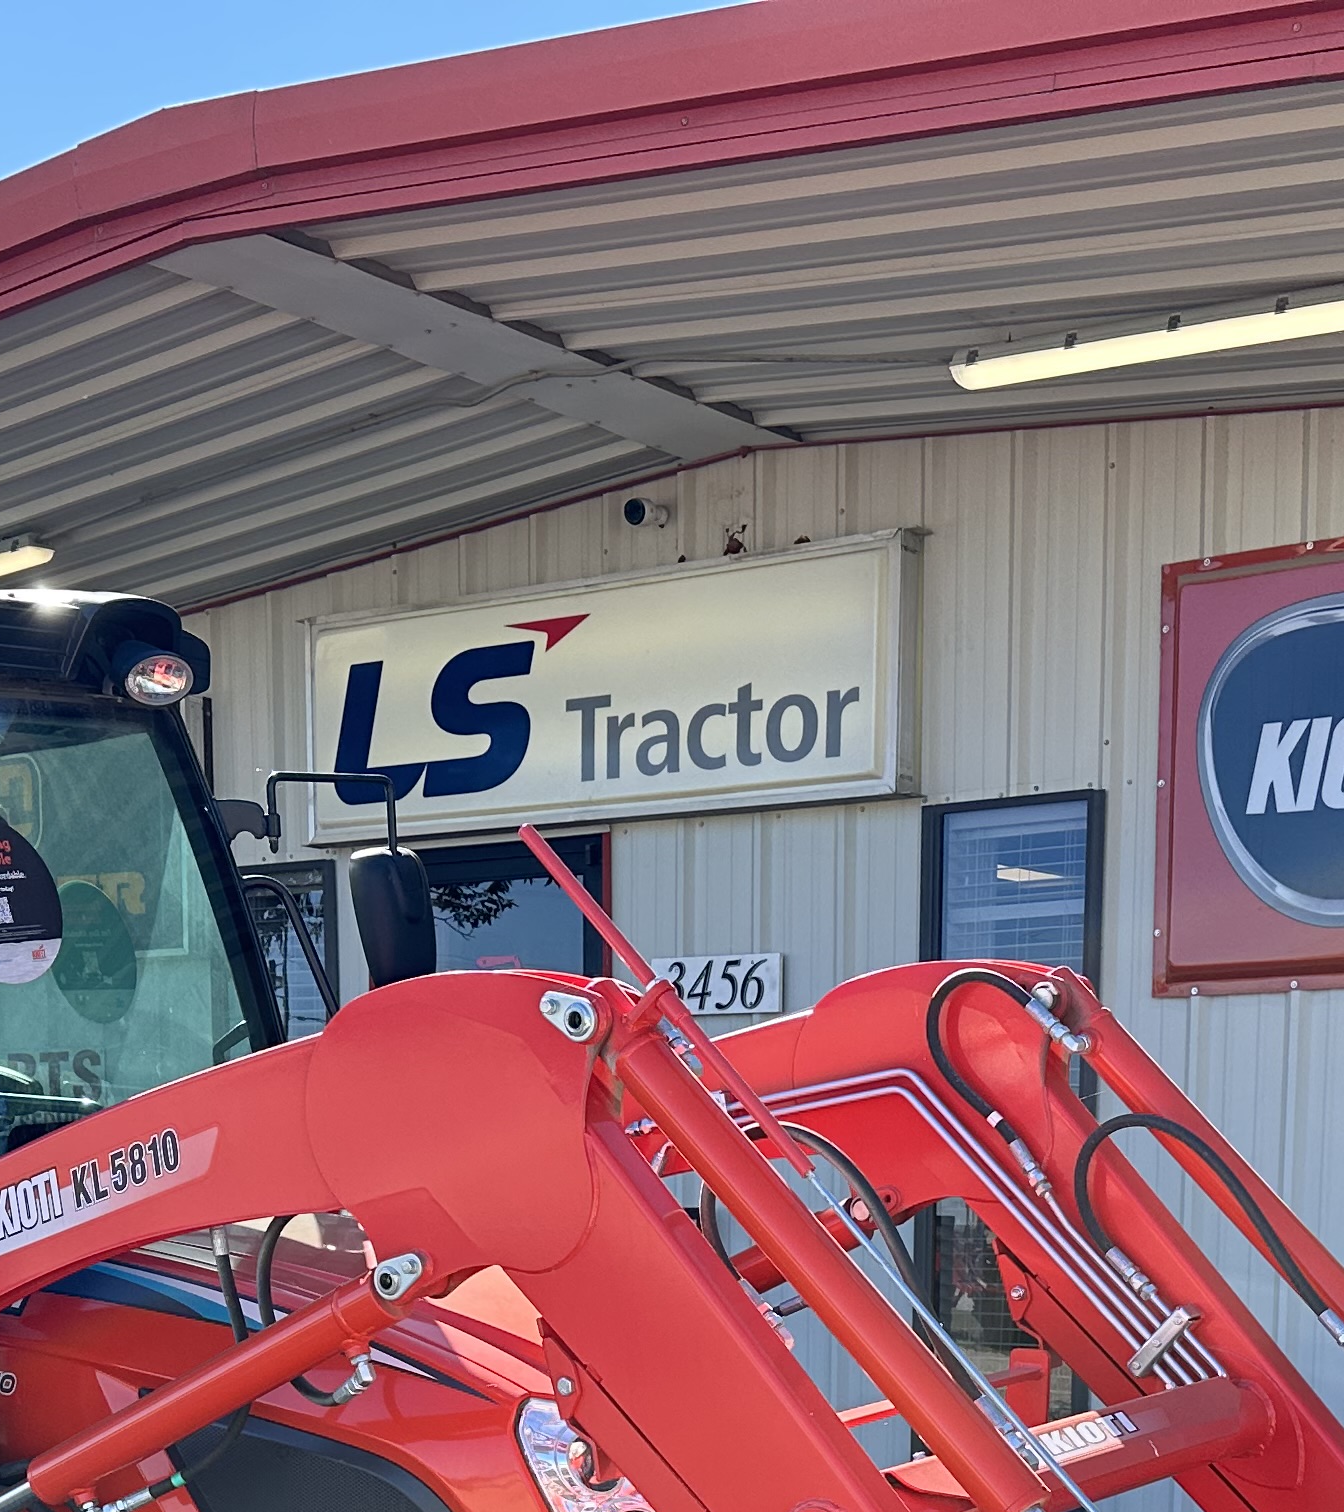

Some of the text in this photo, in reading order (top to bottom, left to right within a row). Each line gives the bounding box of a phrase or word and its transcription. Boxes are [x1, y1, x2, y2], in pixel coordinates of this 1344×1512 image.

[333, 640, 860, 805] LS Tractor
[666, 958, 768, 1010] 3456
[1038, 1410, 1140, 1456] KIOTI
